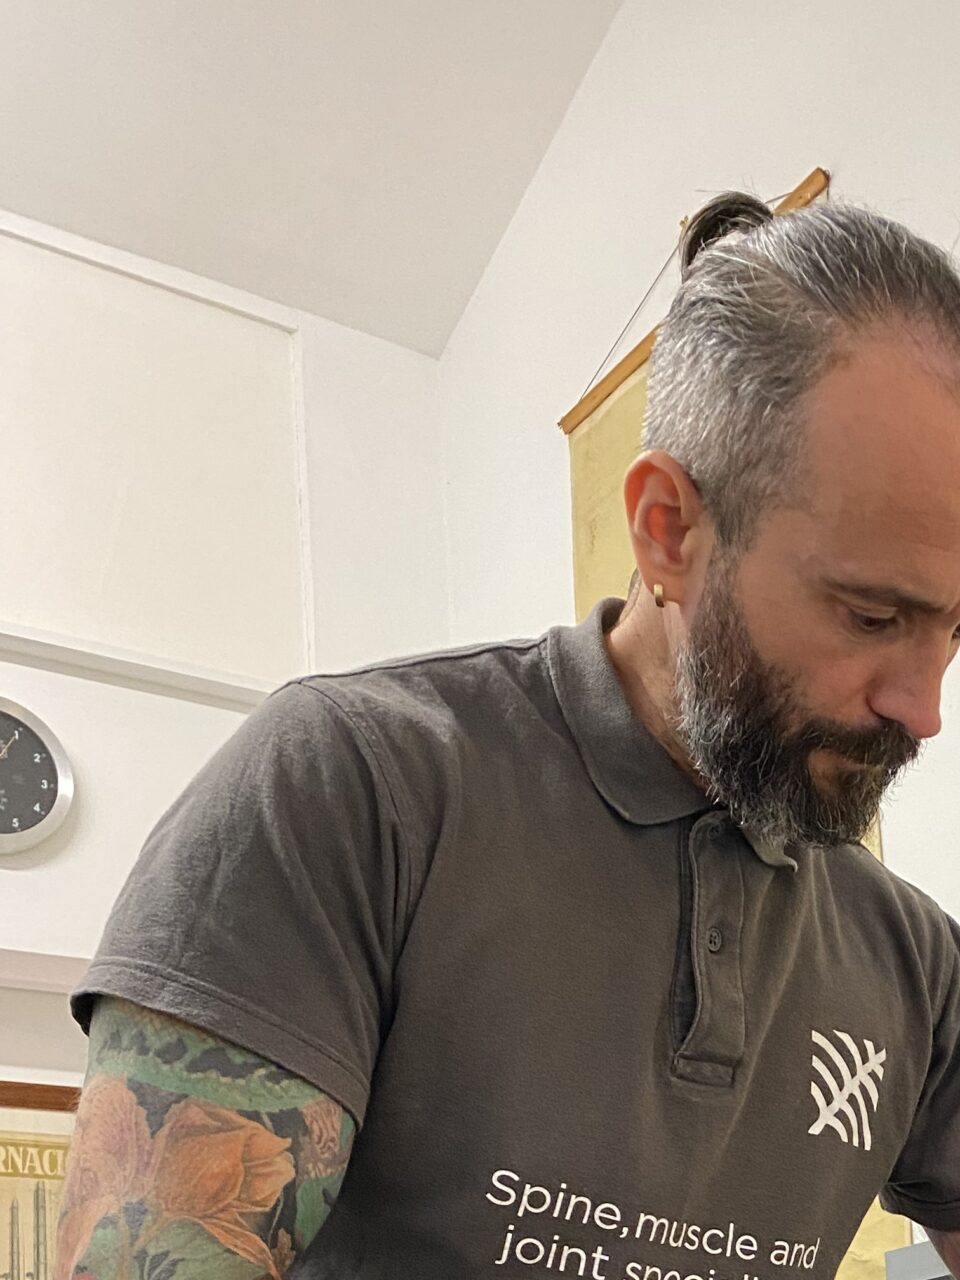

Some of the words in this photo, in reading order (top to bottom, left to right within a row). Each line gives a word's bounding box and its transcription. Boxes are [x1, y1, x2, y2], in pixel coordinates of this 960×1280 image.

[33, 753, 41, 763] 2
[41, 779, 48, 789] 3
[33, 802, 40, 812] 4
[12, 818, 19, 828] 5
[485, 1169, 629, 1239] Spine,
[635, 1212, 758, 1261] muscle
[770, 1237, 821, 1270] and
[494, 1224, 610, 1280] joint
